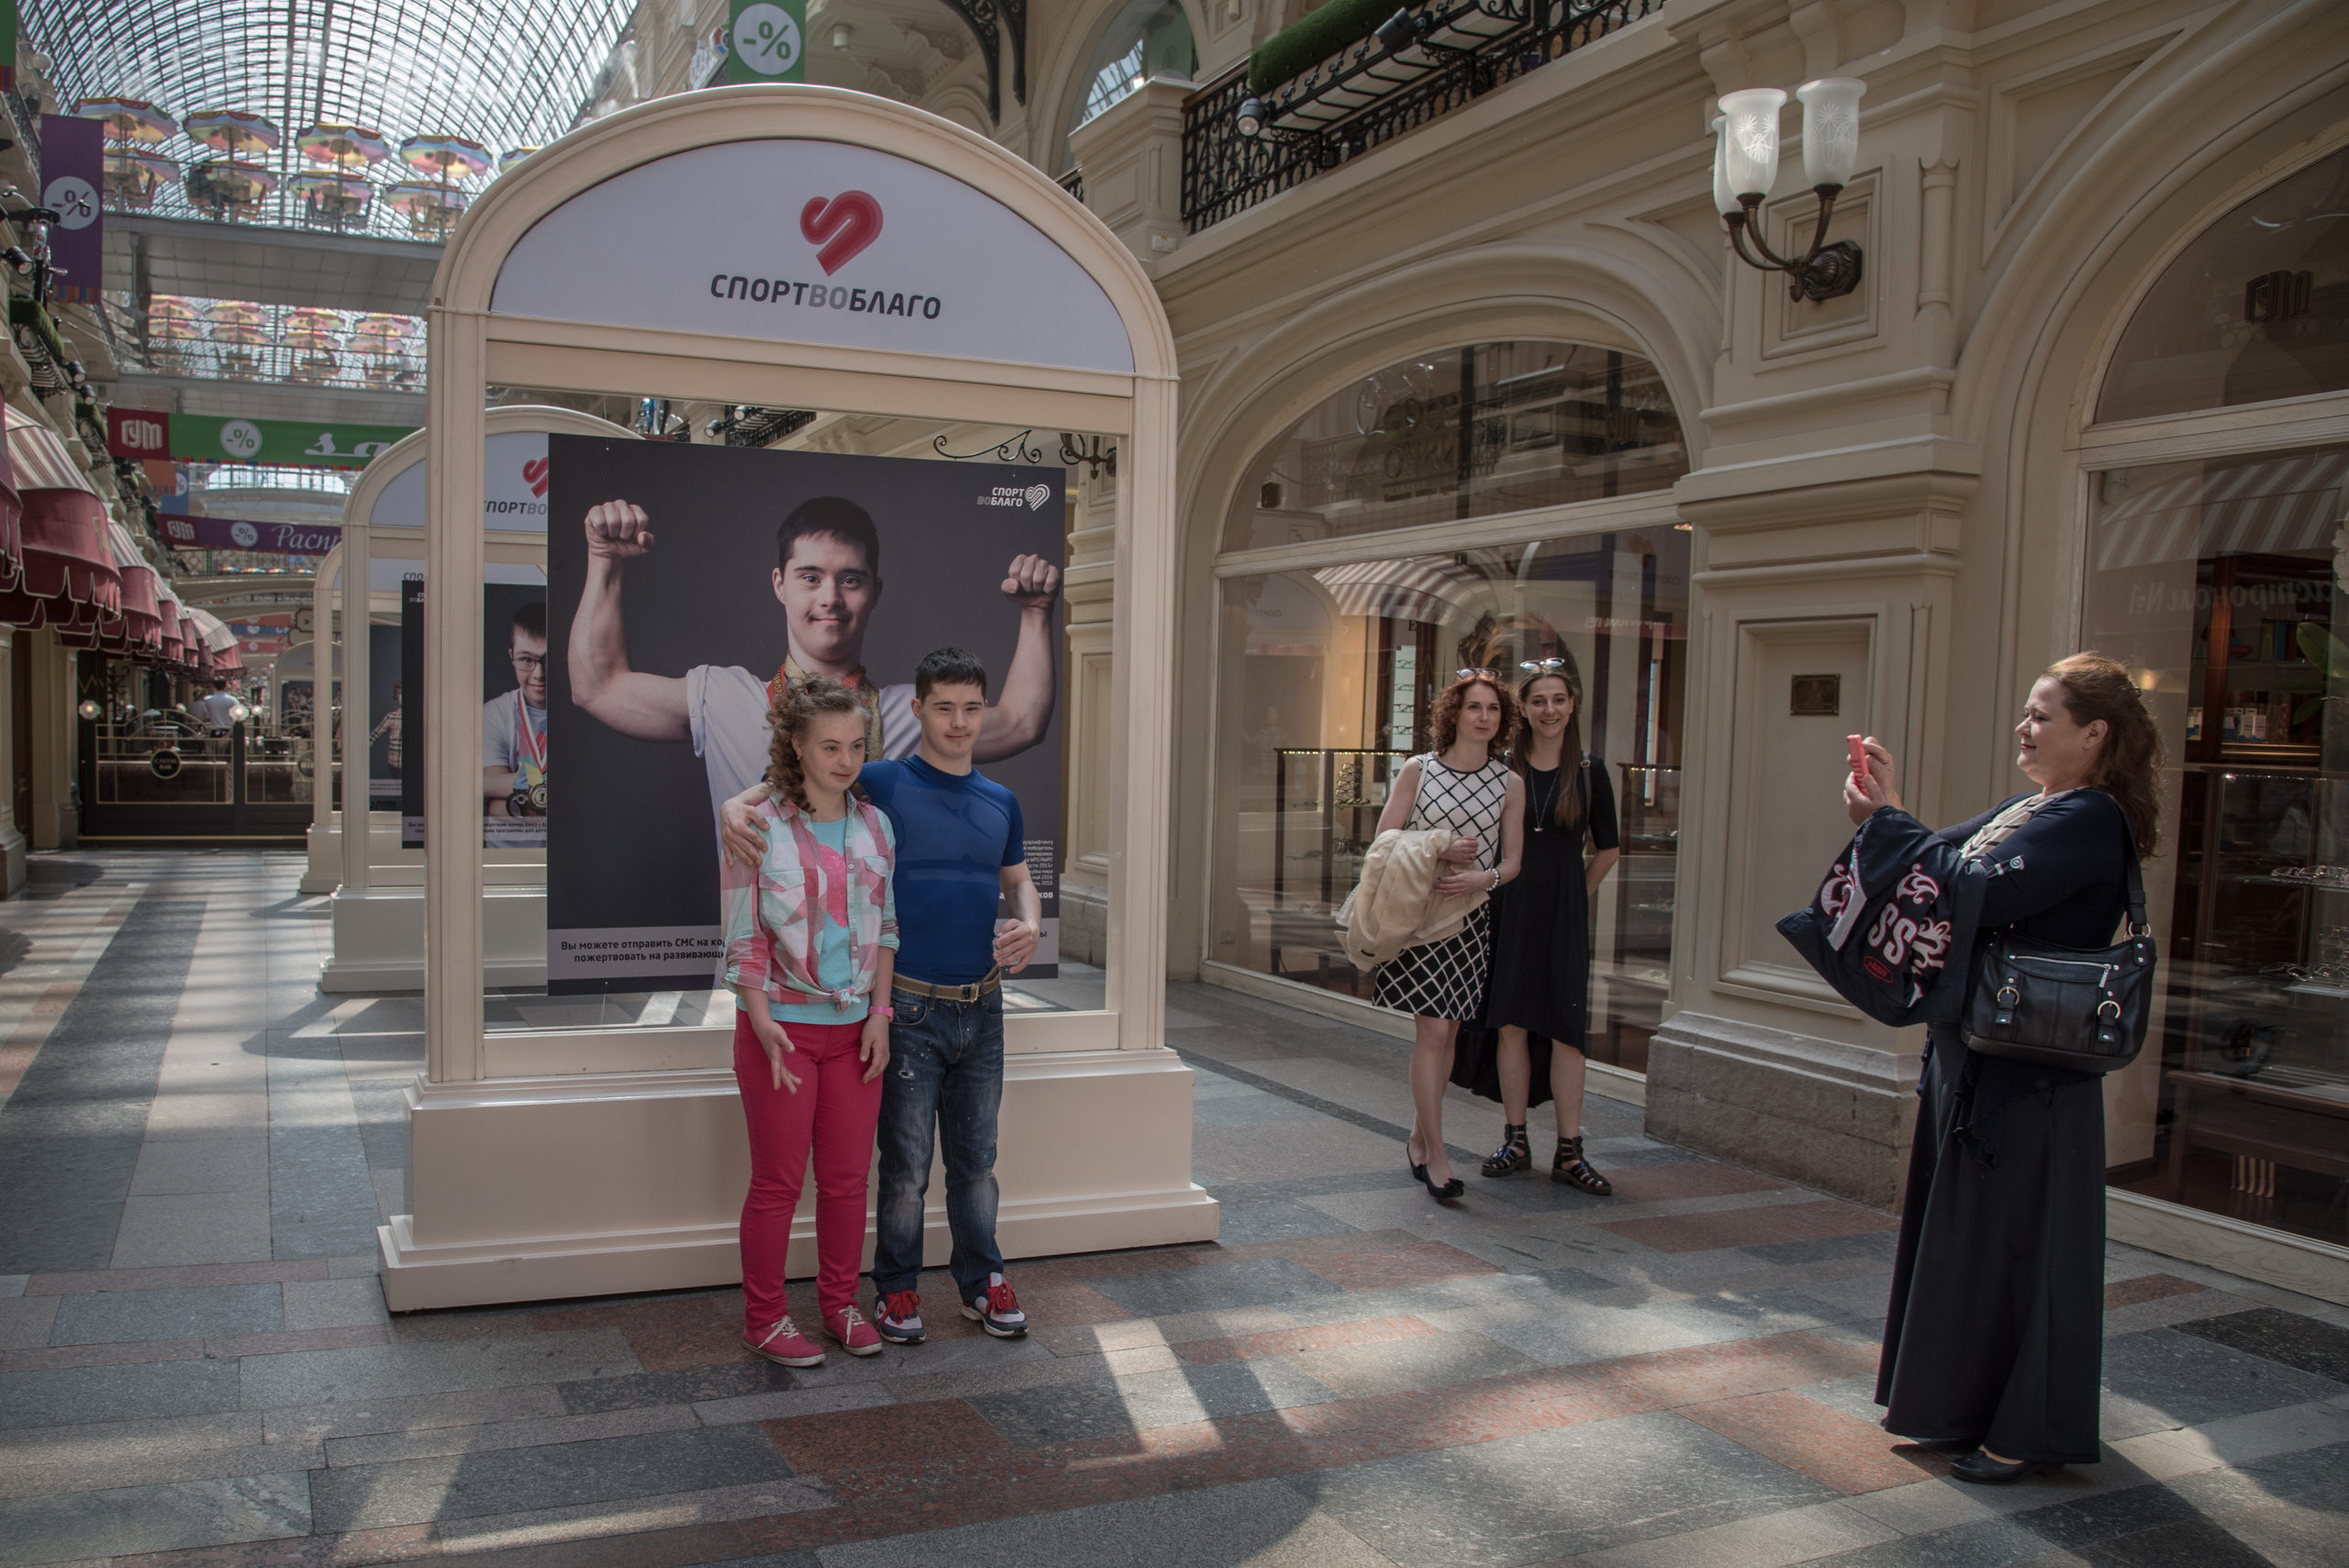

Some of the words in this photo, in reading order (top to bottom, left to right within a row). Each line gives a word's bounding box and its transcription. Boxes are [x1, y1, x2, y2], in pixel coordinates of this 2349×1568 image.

[992, 486, 1025, 497] СПОРТ
[976, 495, 1023, 507] ВОБЛАГО
[561, 940, 576, 951] Вы
[579, 941, 618, 951] можете
[621, 939, 673, 951] отправить
[675, 938, 695, 948] СМС
[697, 939, 708, 947] на
[574, 952, 646, 962] пожертвовать
[649, 951, 661, 960] на
